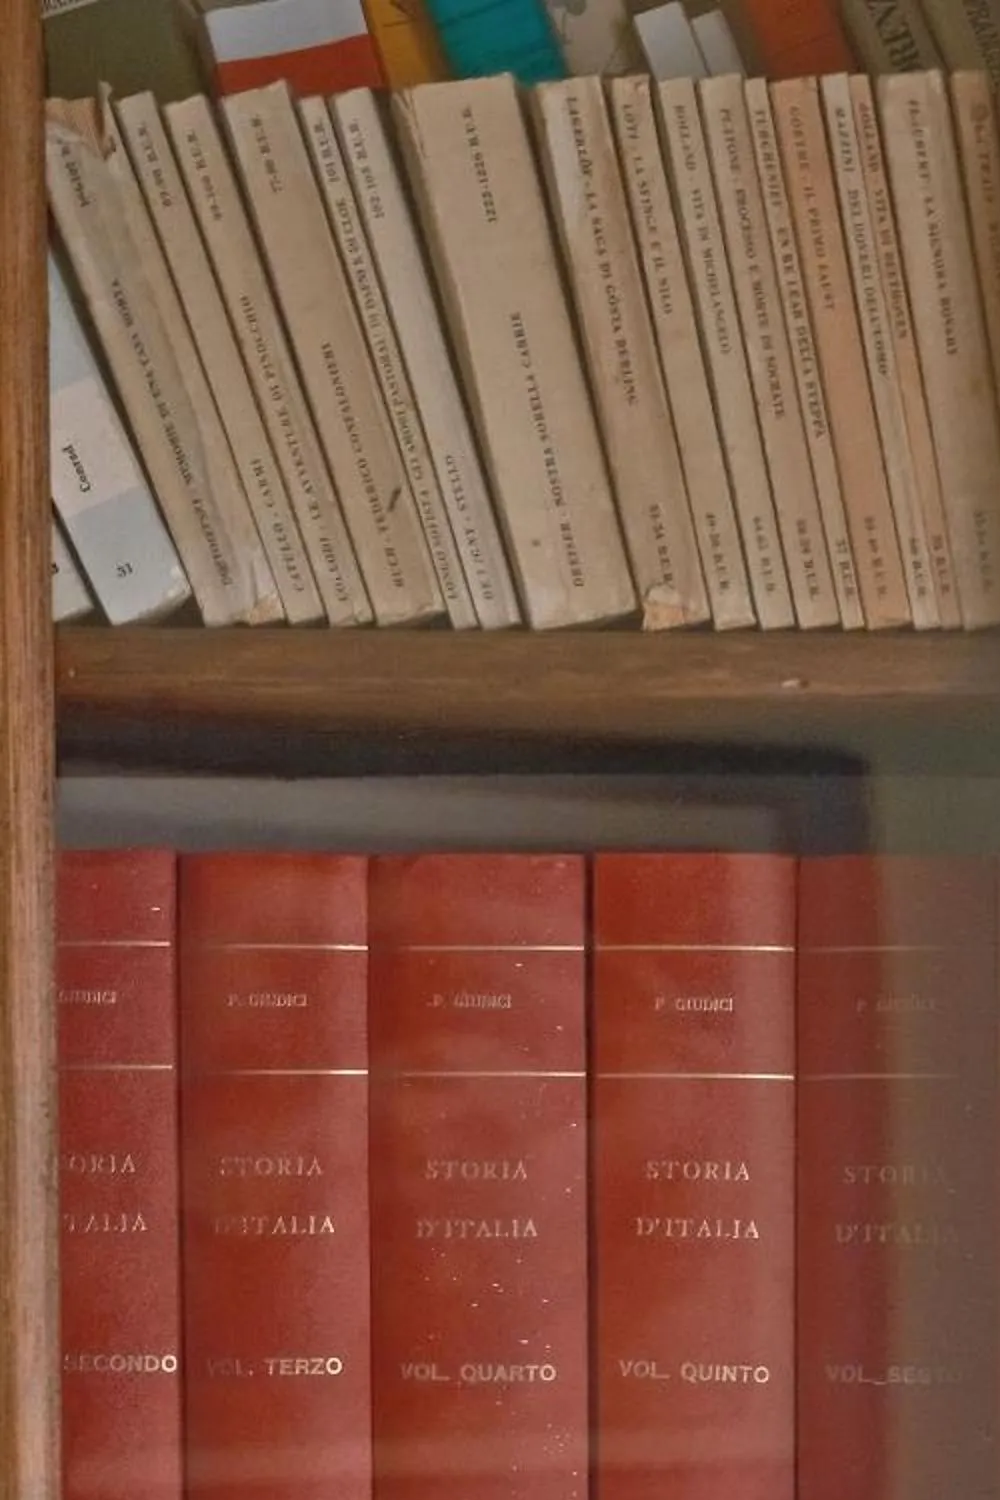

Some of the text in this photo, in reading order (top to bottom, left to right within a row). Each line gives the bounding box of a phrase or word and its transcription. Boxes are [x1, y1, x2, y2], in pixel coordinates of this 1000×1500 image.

[61, 443, 92, 494] Conrad
[675, 994, 734, 1012] GIUDICI
[219, 1156, 324, 1177] STORIA
[424, 1158, 529, 1181] STORIA
[644, 1160, 751, 1182] STORIA
[843, 1163, 950, 1185] STORIA
[213, 1215, 336, 1236] D'ITALIA
[415, 1218, 539, 1239] D'ITALIA
[635, 1217, 760, 1240] D'ITALIA
[834, 1222, 958, 1244] D'ITALIA
[264, 1356, 343, 1377] TERZO
[460, 1362, 557, 1385] QUARTO
[680, 1362, 770, 1385] QUINTO
[888, 1364, 963, 1386] SESTO
